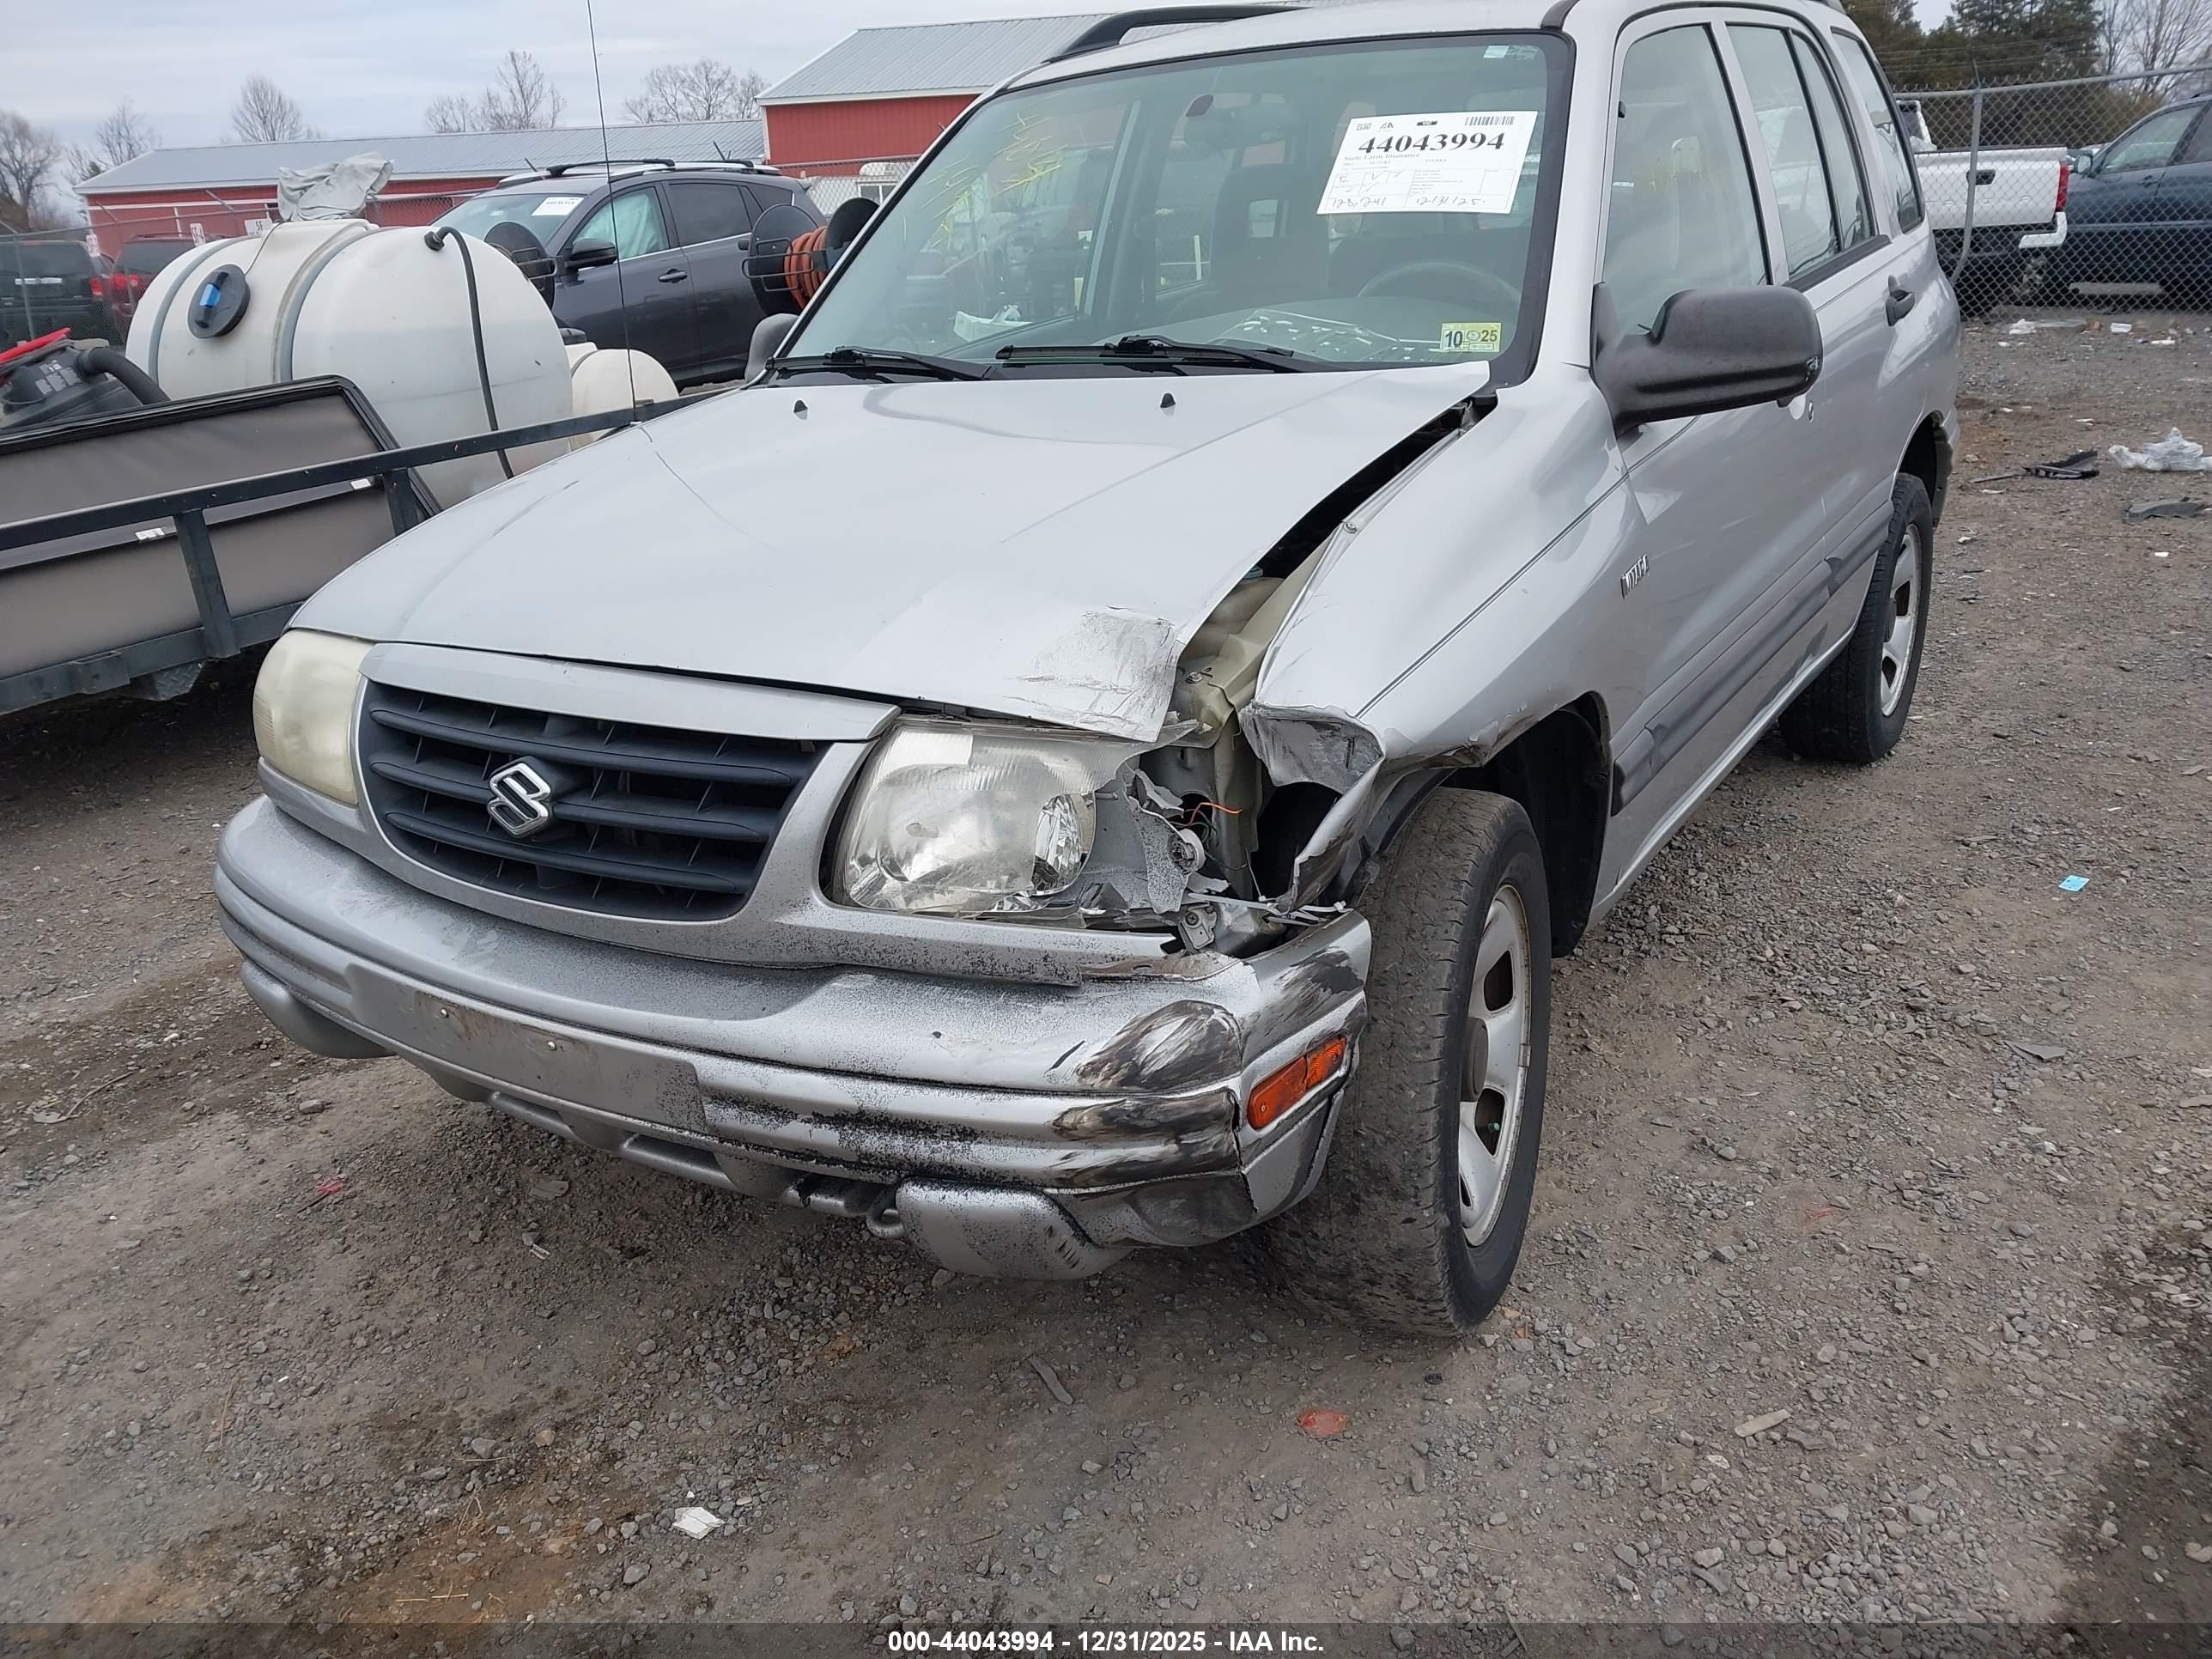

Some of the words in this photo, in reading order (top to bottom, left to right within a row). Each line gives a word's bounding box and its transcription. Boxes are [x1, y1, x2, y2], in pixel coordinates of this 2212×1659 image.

[1358, 132, 1505, 153] 44043994
[1445, 331, 1462, 348] 10
[1480, 330, 1498, 342] 25
